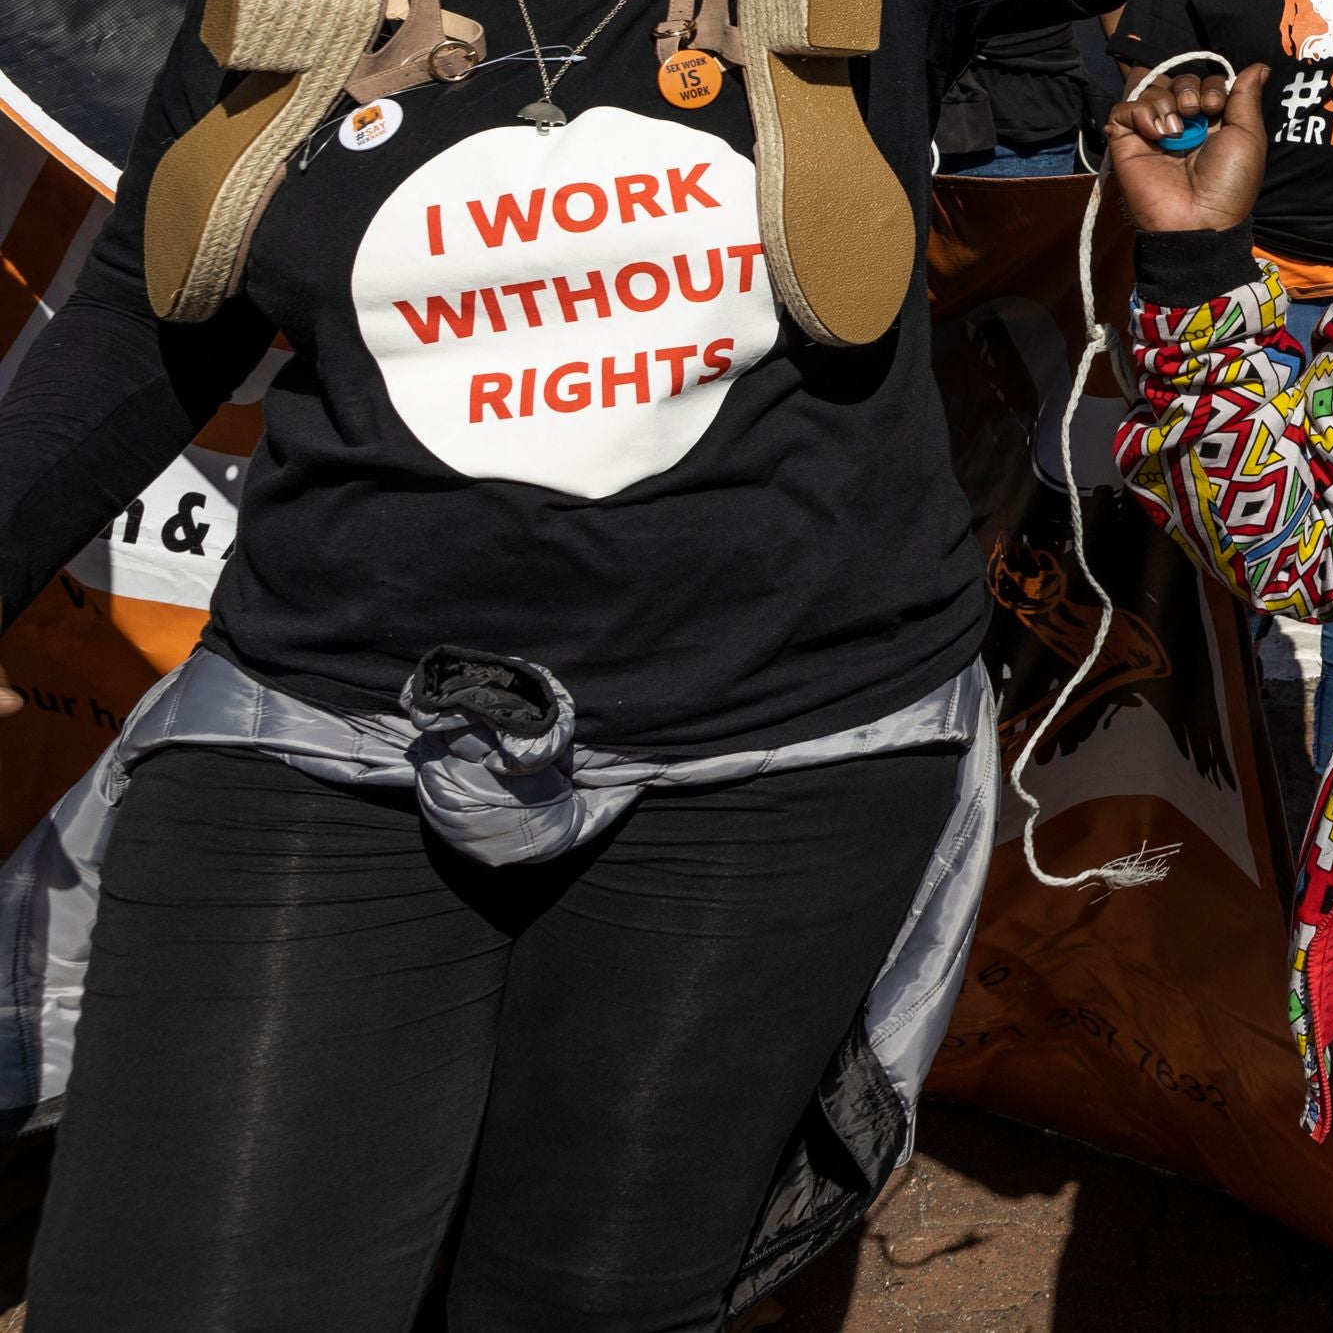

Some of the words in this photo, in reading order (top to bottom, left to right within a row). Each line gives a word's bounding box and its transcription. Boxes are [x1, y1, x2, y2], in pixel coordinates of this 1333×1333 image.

[666, 63, 682, 74] SEX
[681, 57, 707, 70] WORK
[680, 69, 702, 89] IS
[680, 85, 711, 101] WORK
[426, 204, 446, 256] I
[466, 162, 722, 249] WORK
[392, 243, 764, 346] WITHOUT
[469, 337, 735, 424] RIGHTS
[161, 491, 211, 557] &
